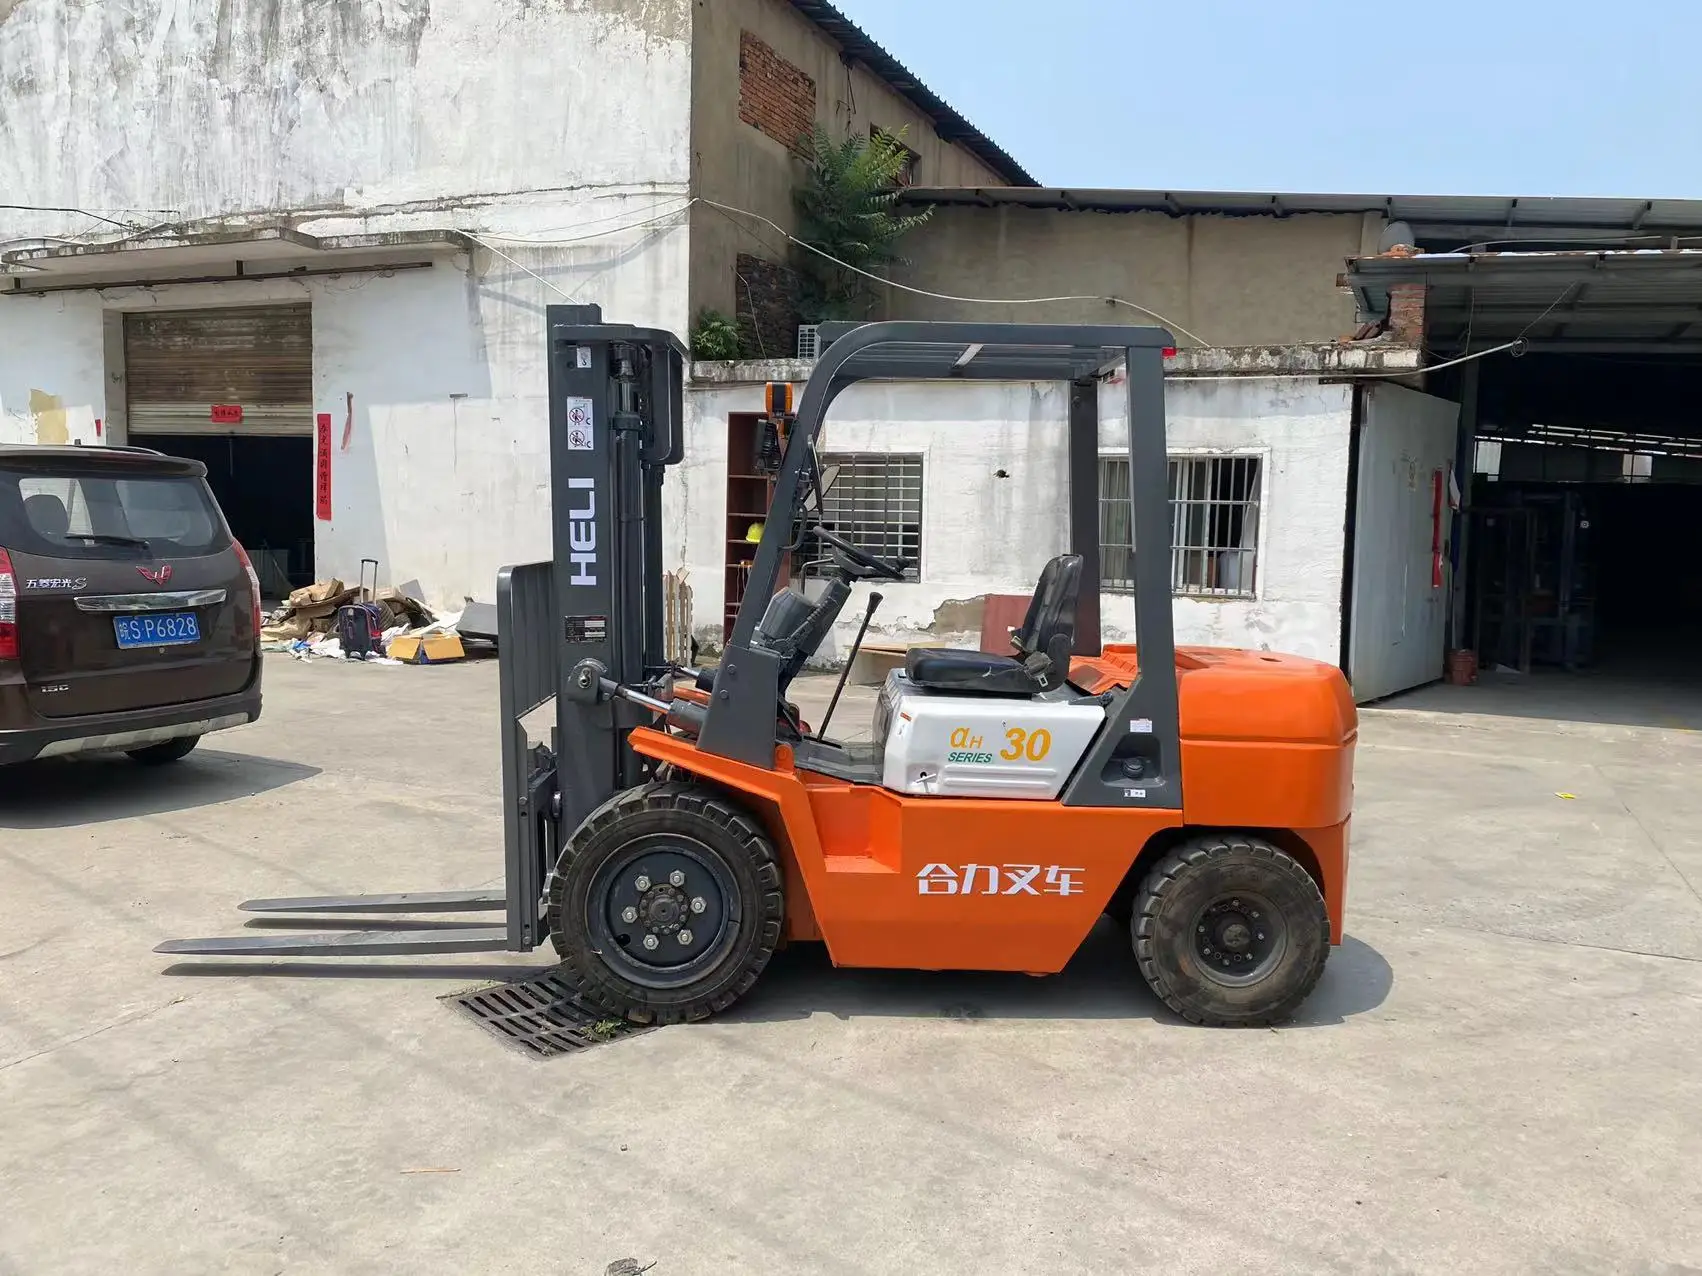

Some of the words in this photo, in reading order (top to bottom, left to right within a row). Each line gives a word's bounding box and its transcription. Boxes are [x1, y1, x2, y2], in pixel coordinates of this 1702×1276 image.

[568, 477, 597, 586] HELI
[948, 752, 993, 763] SERIES
[1000, 727, 1051, 762] 30
[915, 863, 1085, 896] 合力叉车
